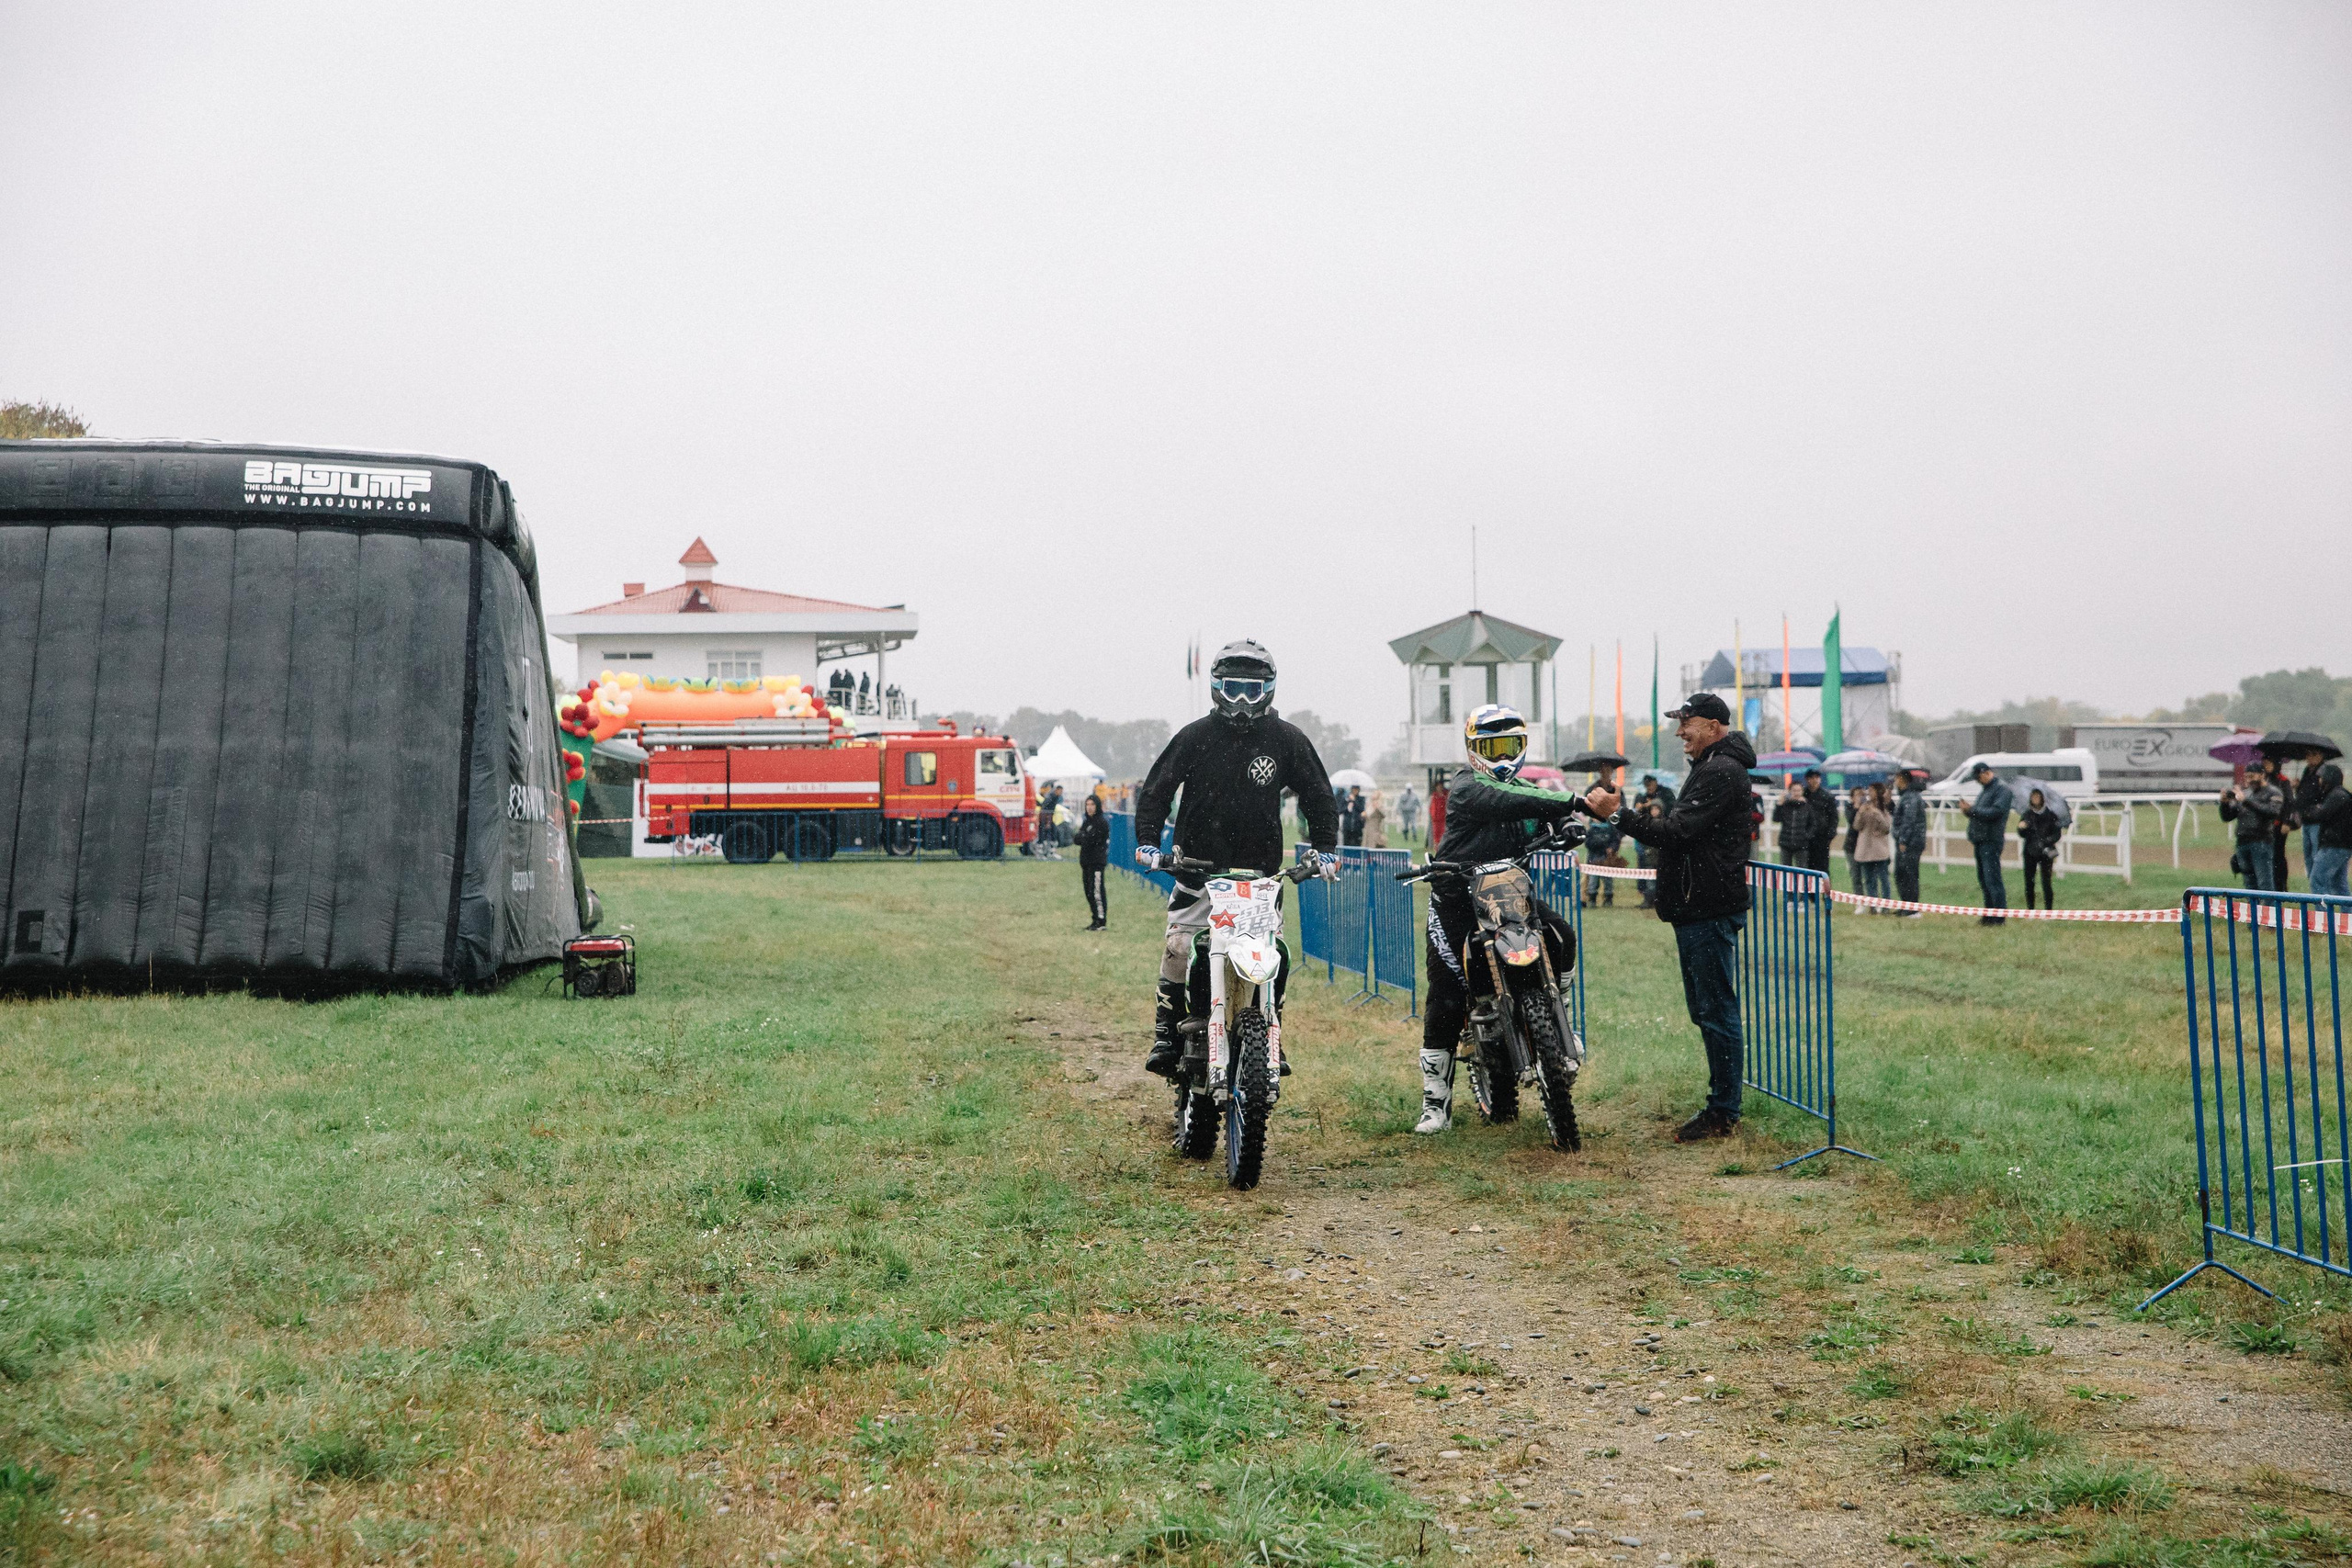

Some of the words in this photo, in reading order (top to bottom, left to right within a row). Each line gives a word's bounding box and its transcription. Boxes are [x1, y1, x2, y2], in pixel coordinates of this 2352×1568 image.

[244, 460, 432, 499] BAGJUMP
[244, 483, 261, 491] THE
[262, 485, 300, 494] ORIGINAL
[243, 493, 431, 513] WWW.BAGJUMP.COM
[2095, 738, 2132, 751] EURO
[2165, 743, 2207, 757] GROU
